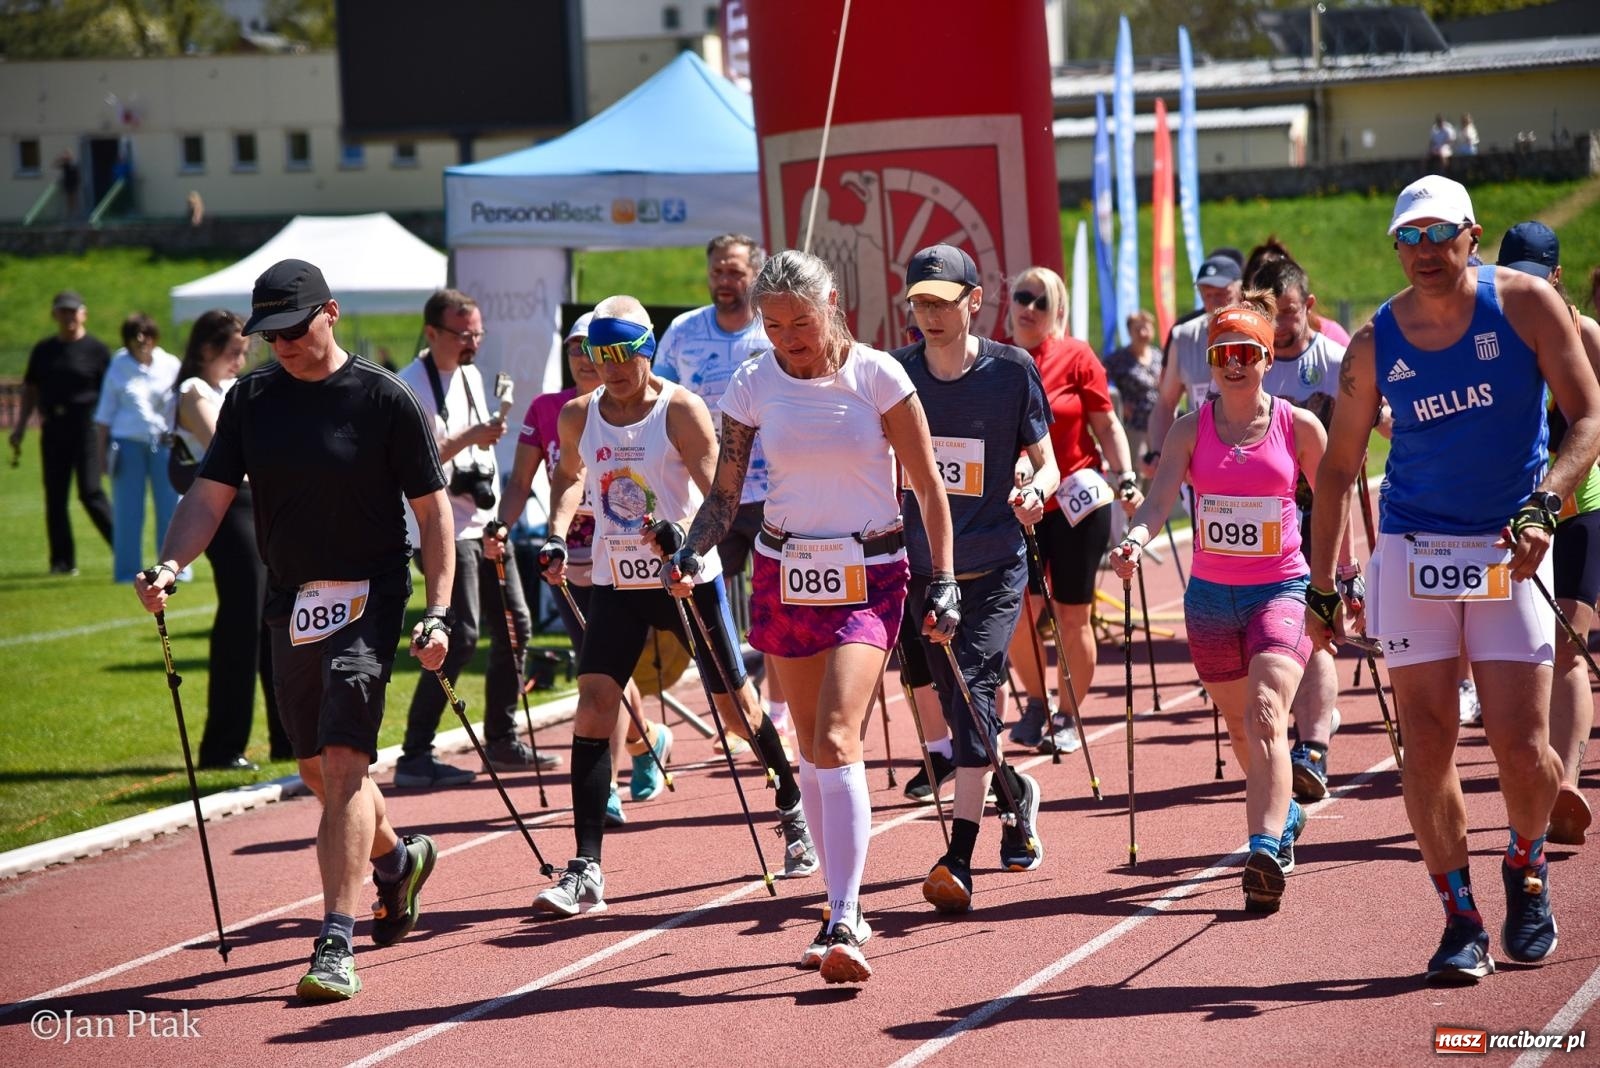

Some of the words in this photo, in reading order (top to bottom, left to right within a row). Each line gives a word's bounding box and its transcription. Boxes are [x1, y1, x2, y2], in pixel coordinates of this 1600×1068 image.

[471, 201, 603, 224] PersonalBest
[1216, 313, 1258, 325] LEKI
[1387, 370, 1417, 383] adidas
[1413, 383, 1494, 422] HELLAS
[1069, 485, 1100, 514] 097
[1208, 521, 1258, 546] 098
[1461, 541, 1488, 549] GRANIC
[619, 558, 662, 579] 082
[1419, 565, 1482, 589] 096
[789, 568, 841, 594] 086
[296, 602, 346, 632] 088
